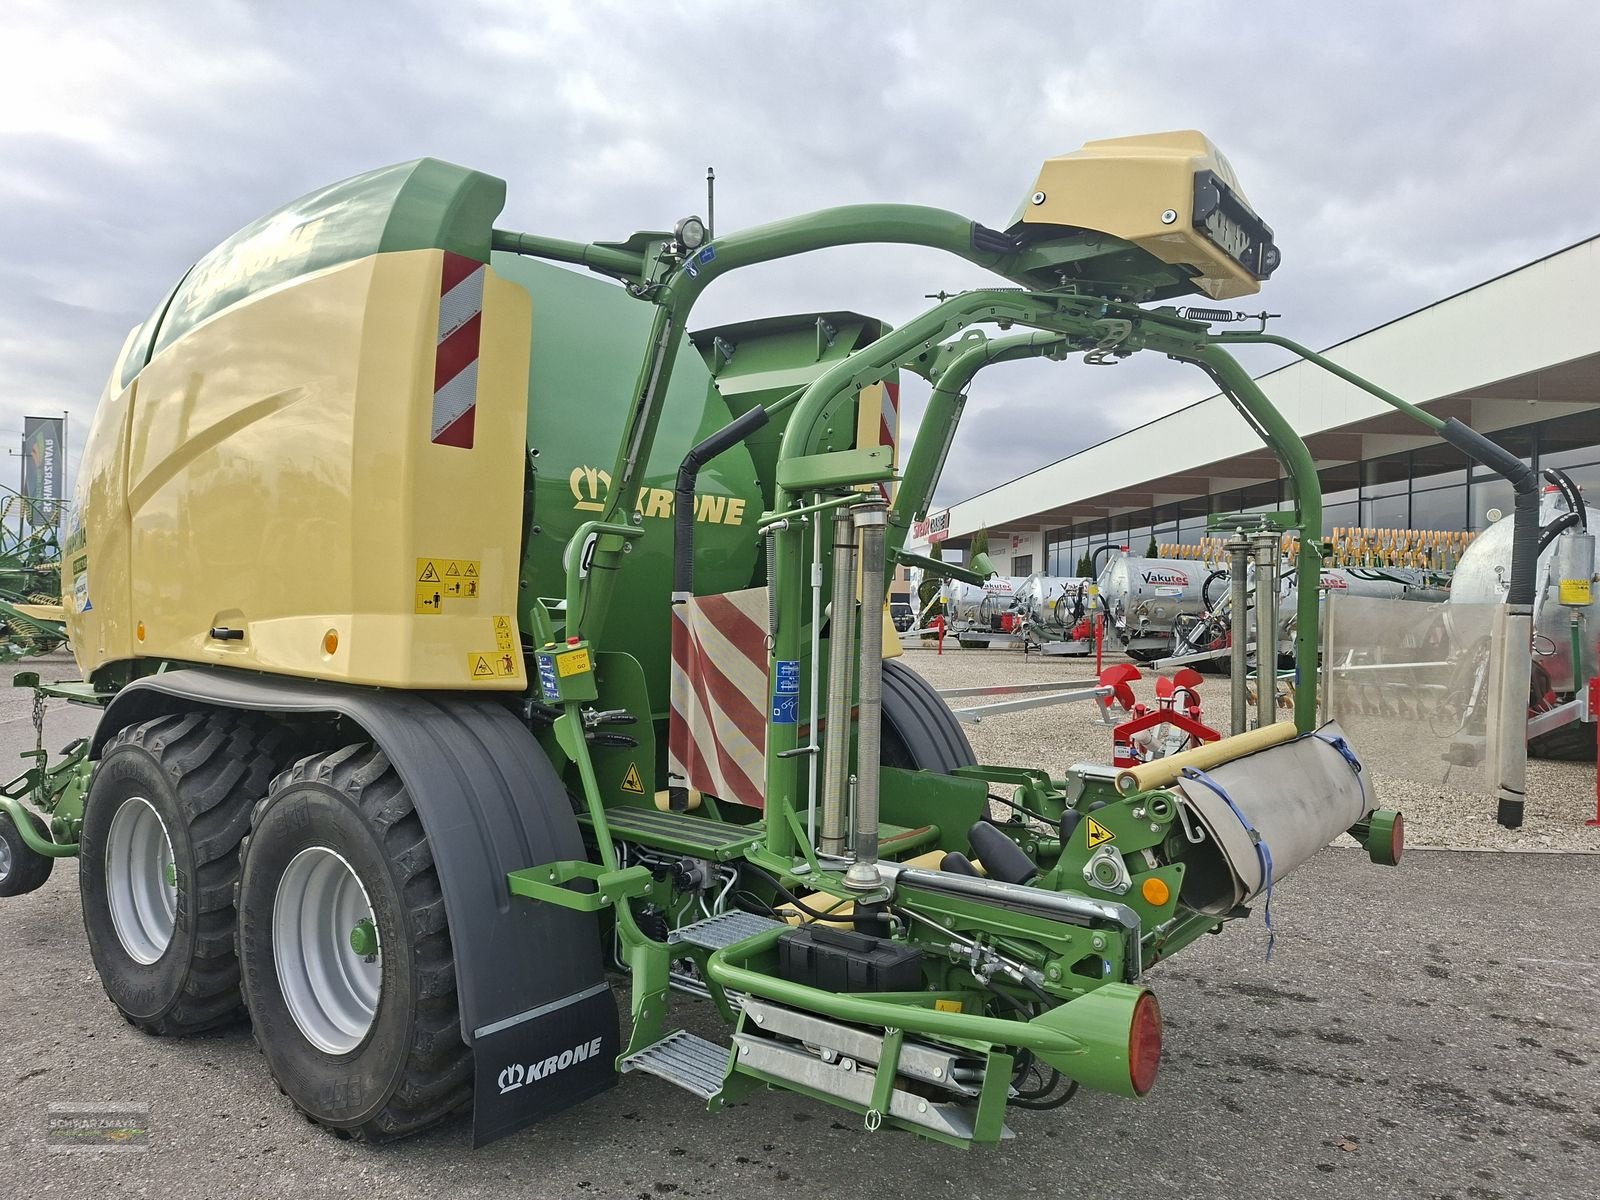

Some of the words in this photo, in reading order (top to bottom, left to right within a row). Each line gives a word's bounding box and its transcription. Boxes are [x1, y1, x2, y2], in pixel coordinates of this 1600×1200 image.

[1141, 571, 1189, 584] Vakutec
[571, 652, 587, 661] STOP
[525, 1036, 602, 1085] KRONE
